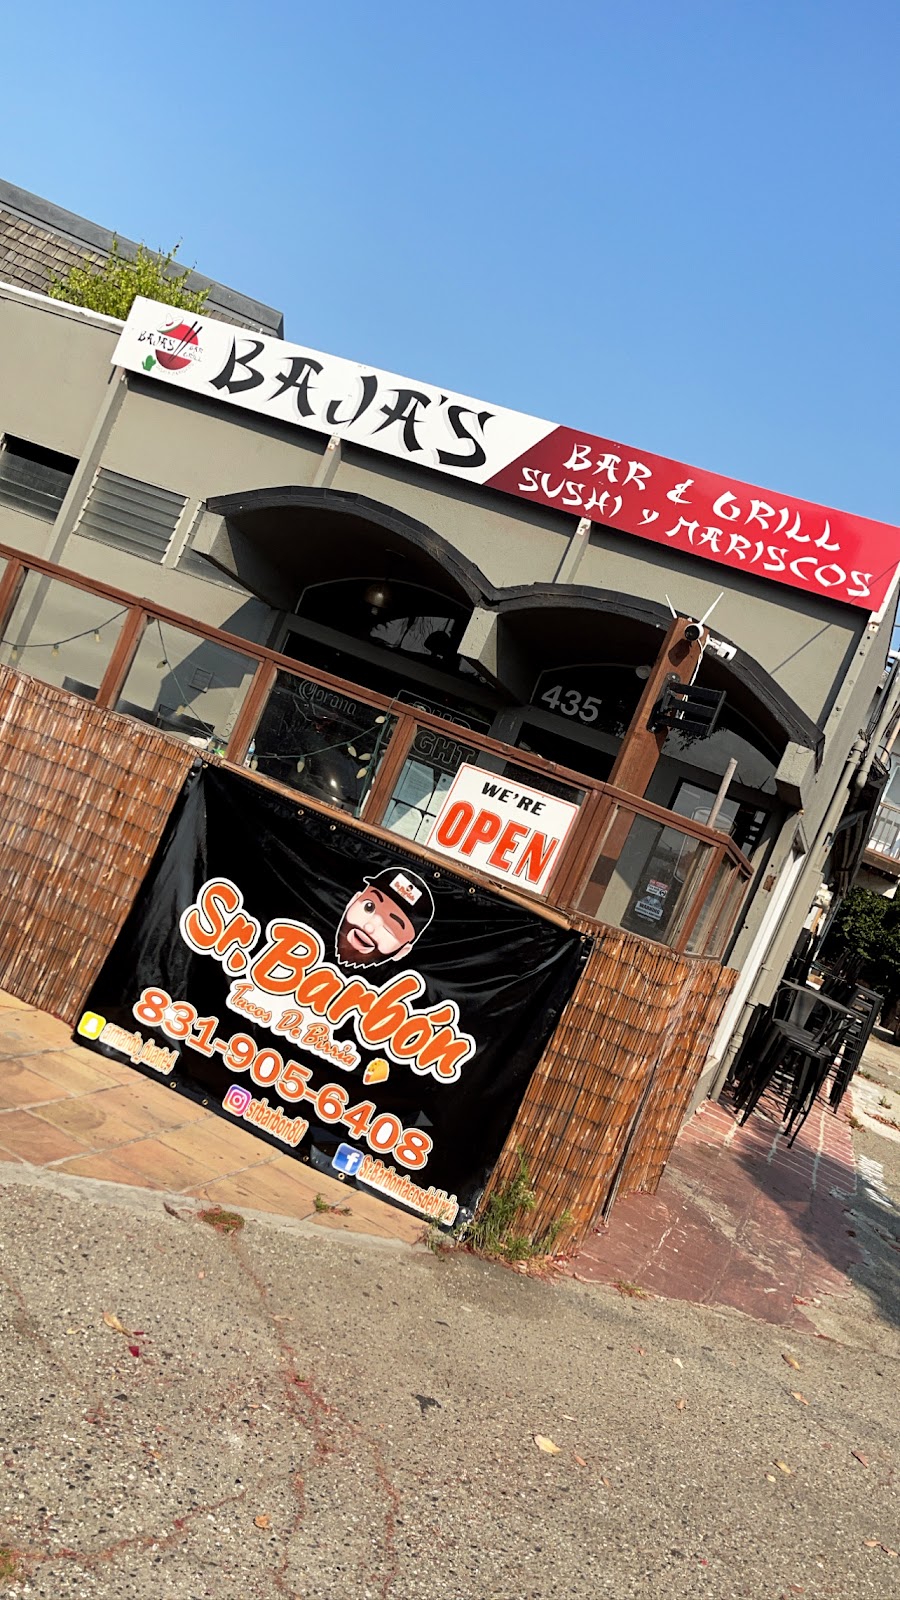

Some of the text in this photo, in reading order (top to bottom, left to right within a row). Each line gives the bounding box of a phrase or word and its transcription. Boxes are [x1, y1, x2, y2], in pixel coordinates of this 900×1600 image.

[209, 333, 497, 468] BAJA'S
[518, 467, 623, 518] SUSHI
[665, 517, 874, 598] MARISCOS
[562, 443, 841, 552] BAR & GRILL
[540, 685, 603, 722] 435
[435, 799, 560, 885] OPEN
[481, 781, 547, 816] WE'RE
[230, 983, 358, 1067] Tacos De Birria
[250, 921, 473, 1080] Barbón
[134, 989, 431, 1169] 831-905-6408
[245, 1100, 307, 1145] srbarbon80
